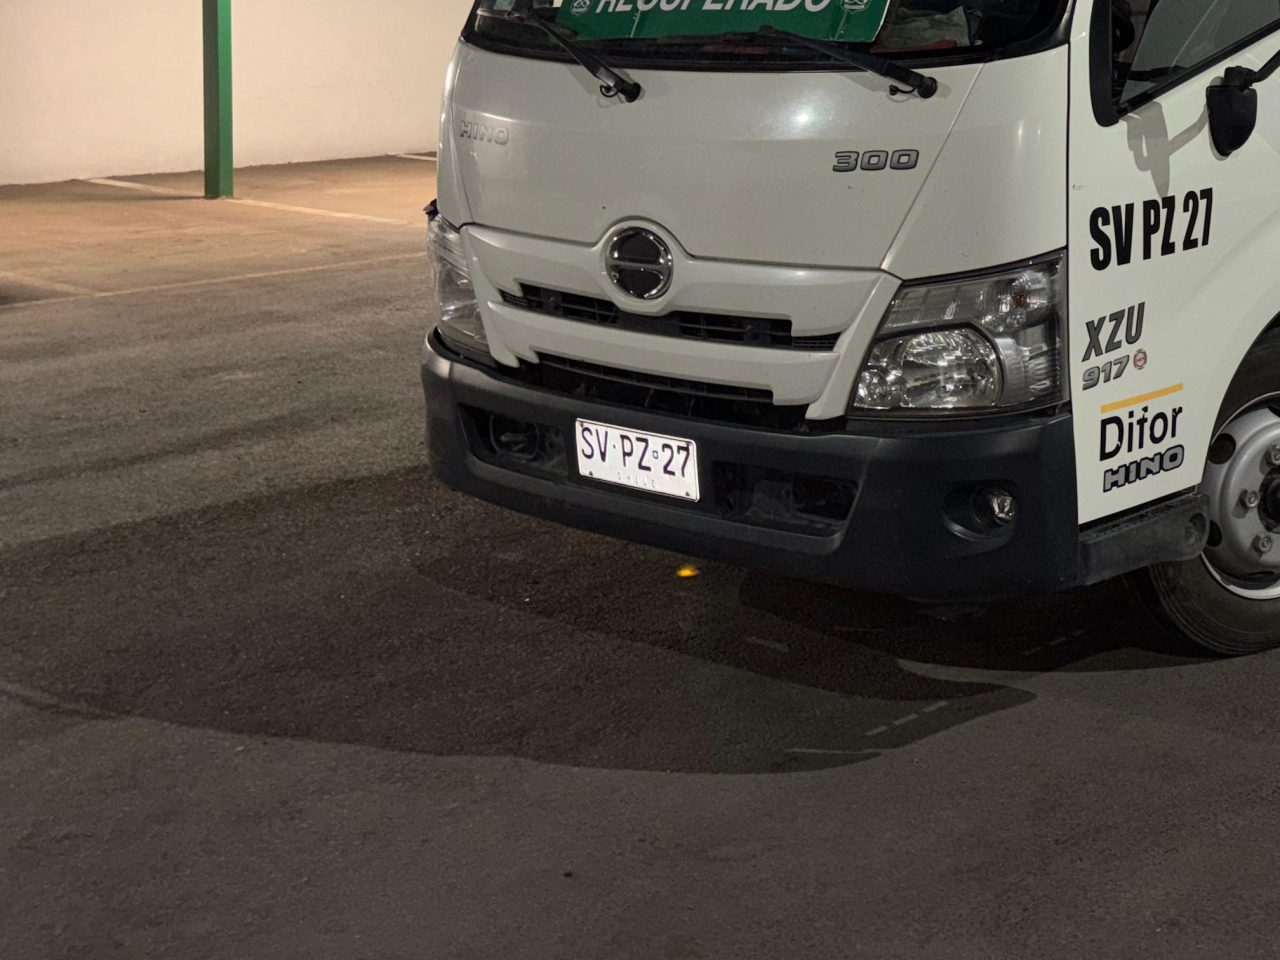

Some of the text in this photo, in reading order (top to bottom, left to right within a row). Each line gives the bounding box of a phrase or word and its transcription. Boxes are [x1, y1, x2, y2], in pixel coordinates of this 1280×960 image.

[460, 120, 509, 145] HINO
[832, 149, 919, 172] 300
[1089, 187, 1213, 271] SV PZ 27
[1081, 301, 1145, 362] XZU
[1082, 354, 1130, 391] 917
[1102, 444, 1185, 493] HINO
